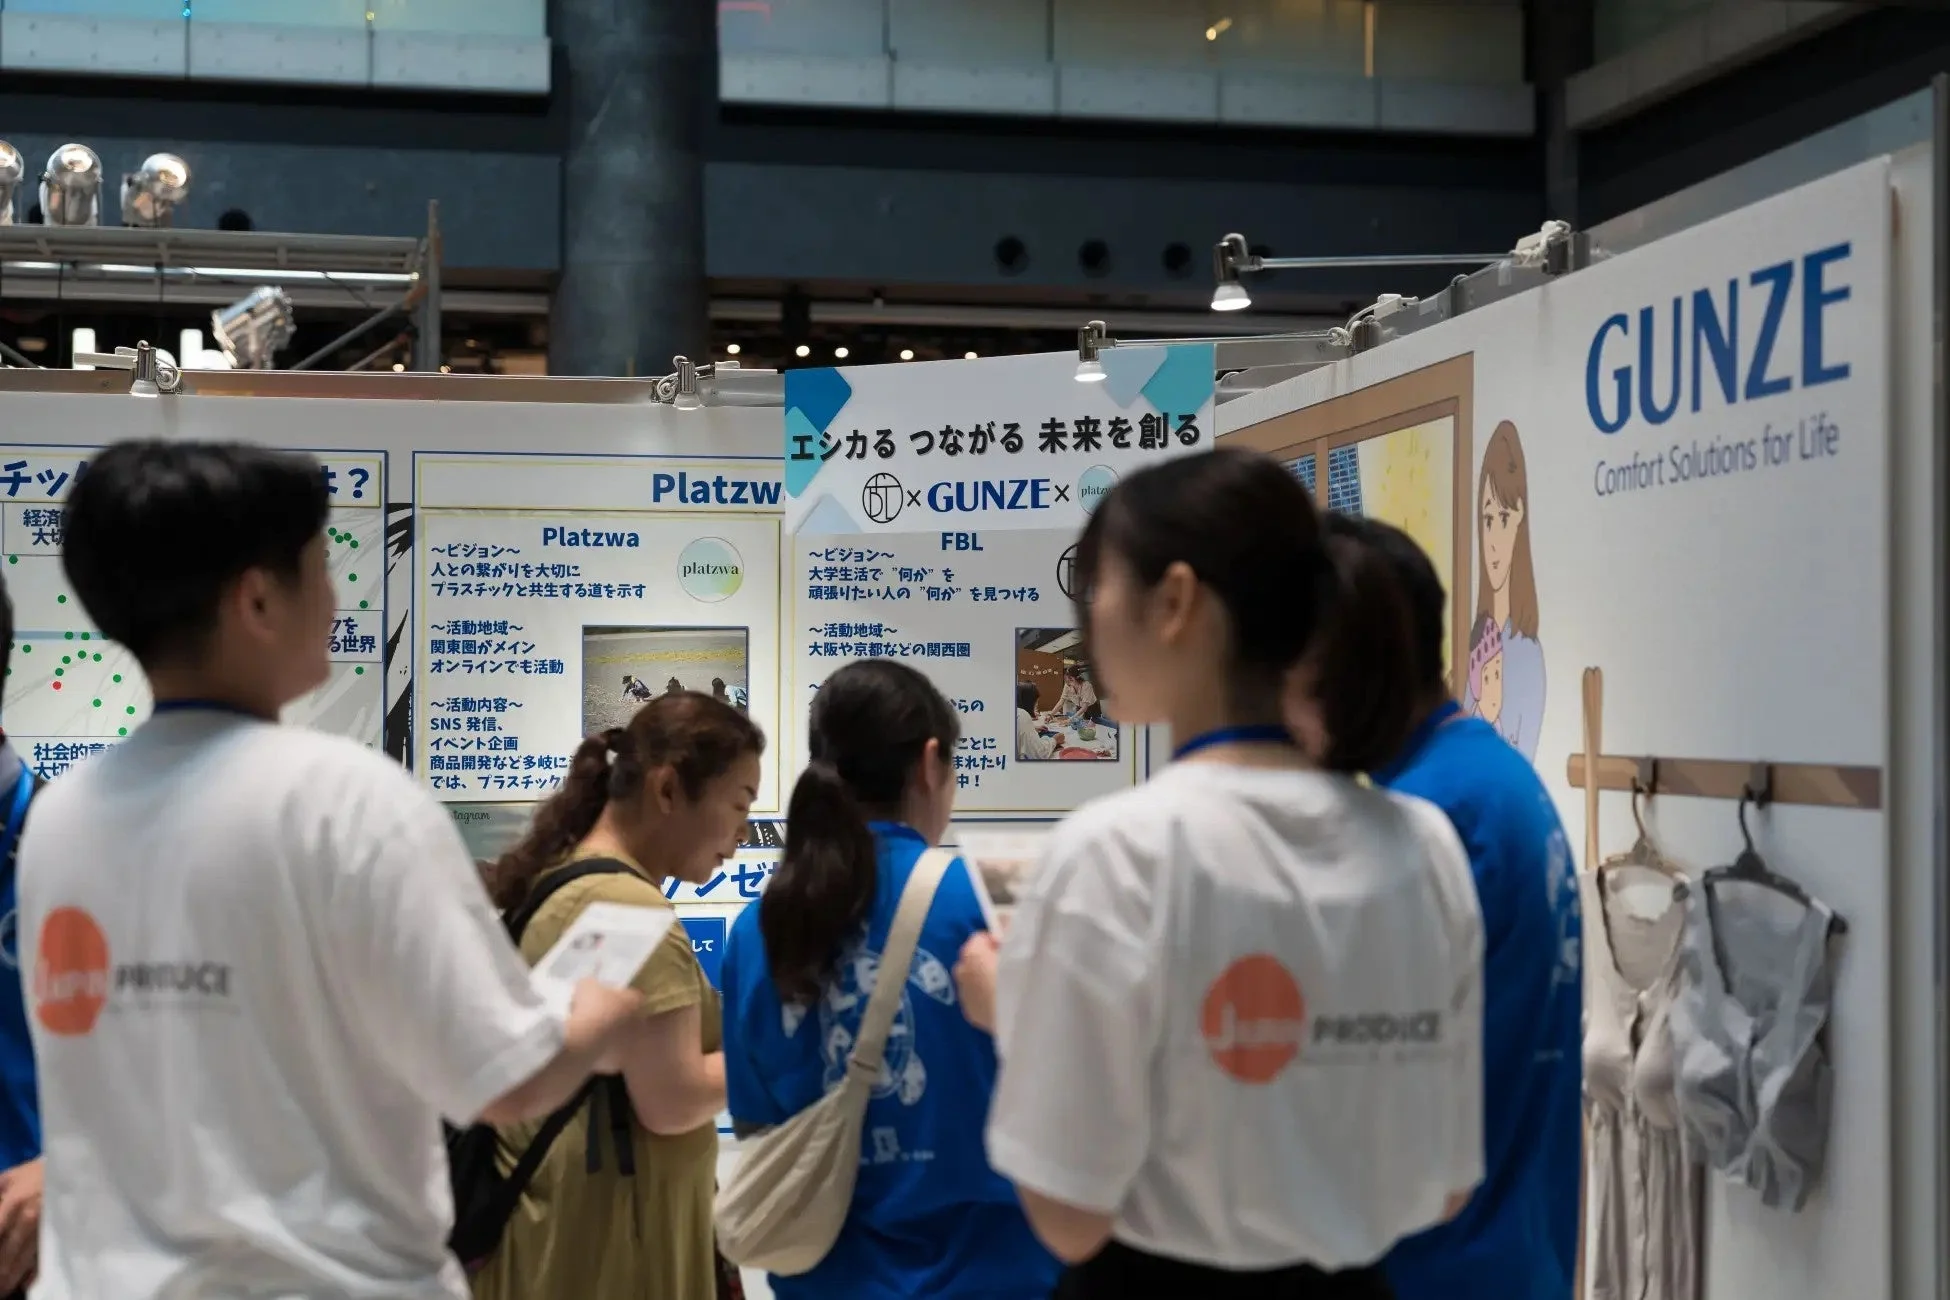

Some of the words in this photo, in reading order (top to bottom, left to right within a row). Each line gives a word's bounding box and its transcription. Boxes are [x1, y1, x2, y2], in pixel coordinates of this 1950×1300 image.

[1586, 242, 1852, 434] GUNZE
[790, 428, 896, 461] エシカる
[909, 422, 1024, 456] つながる
[1038, 412, 1201, 454] 未来を創る
[1594, 451, 1665, 496] Comfort
[1669, 435, 1757, 483] Solutions
[1762, 424, 1793, 466] for
[1799, 411, 1840, 461] Life
[653, 472, 785, 505] Platzw
[928, 479, 1050, 512] GUNZE
[23, 508, 66, 527] 経済
[543, 527, 640, 548] Platzwa
[942, 532, 983, 551] FBL
[430, 562, 581, 578] 人との繋がりを大切に
[682, 561, 739, 577] platzwa
[431, 581, 647, 598] プラスチックと共生する道を示す
[430, 639, 536, 655] 関東圏がメイン
[808, 642, 971, 657] 大阪や京都などの関西圏
[430, 659, 564, 674] オンラインでも活動
[950, 698, 984, 713] らの
[430, 717, 462, 731] SNS
[430, 736, 518, 751] イベント企画
[430, 755, 574, 770] 商品開発など多岐に
[430, 775, 567, 789] では、プラスチック
